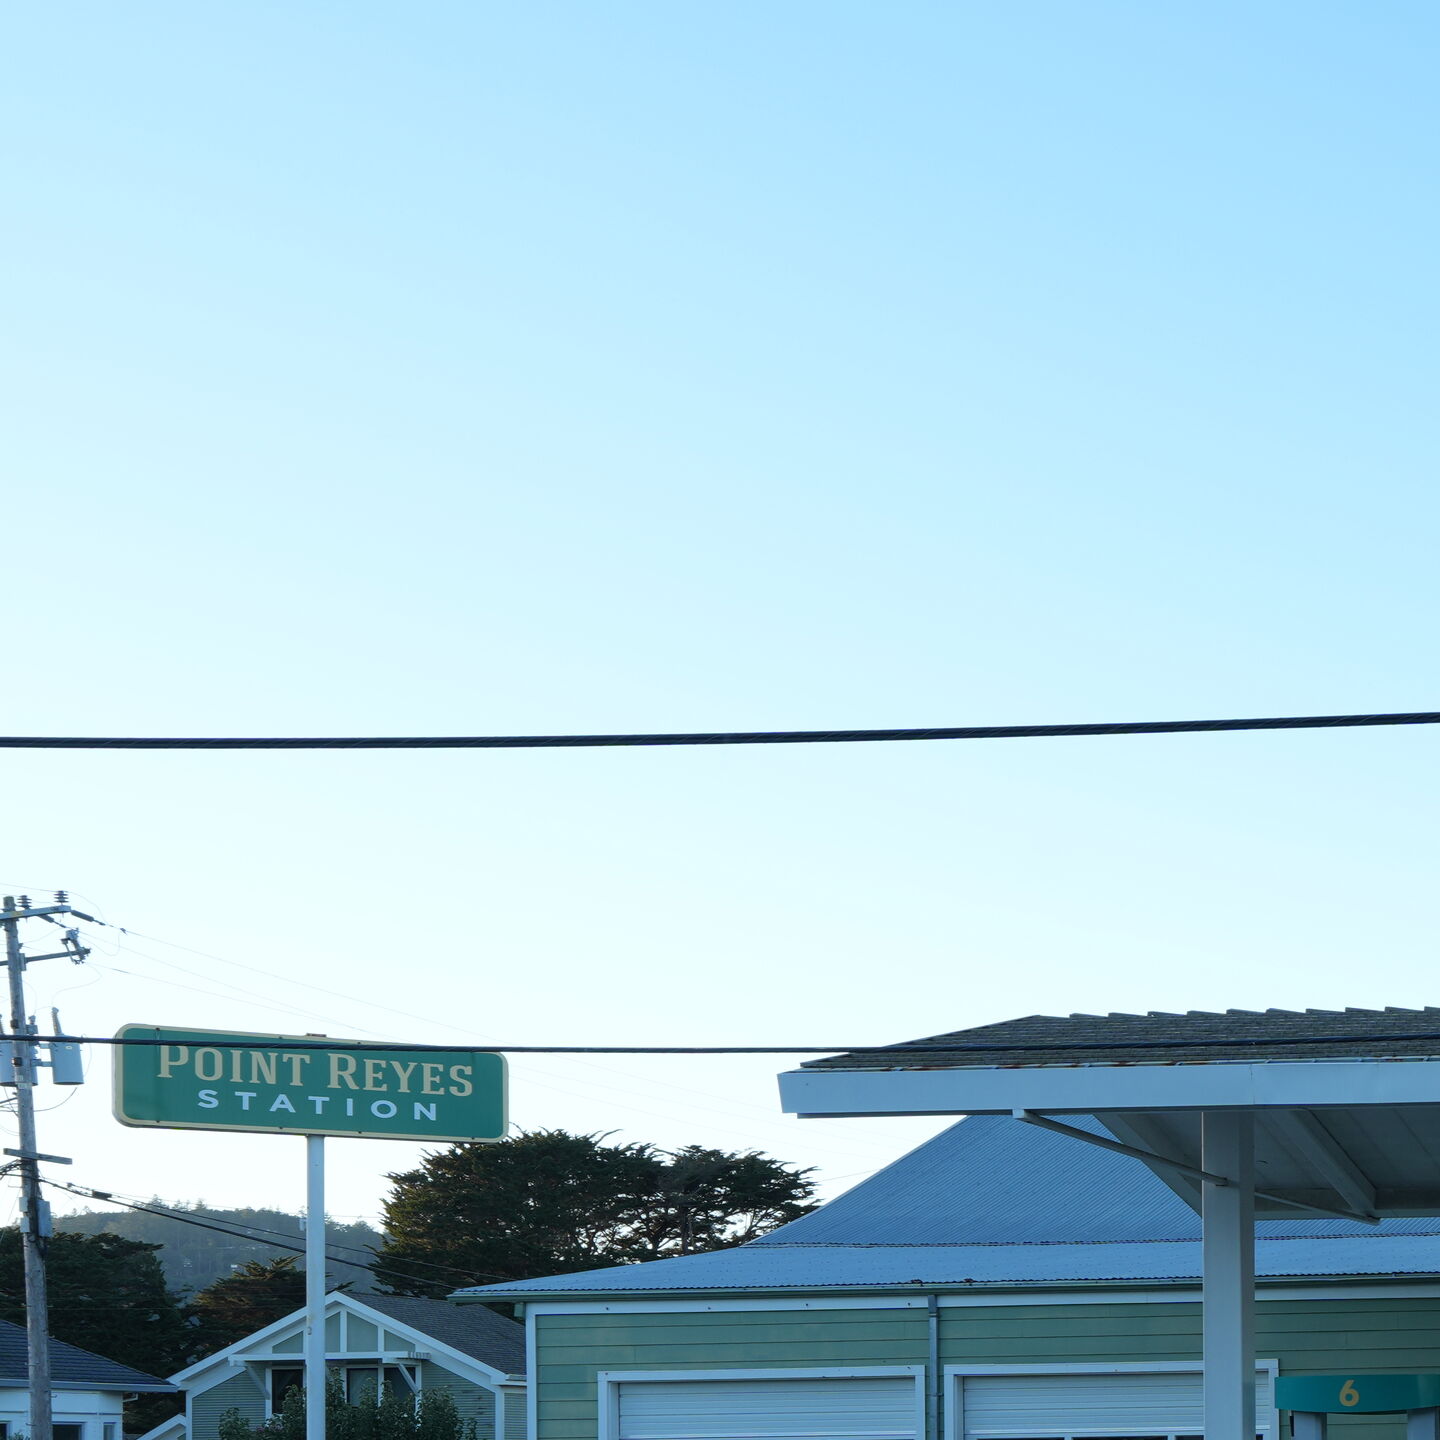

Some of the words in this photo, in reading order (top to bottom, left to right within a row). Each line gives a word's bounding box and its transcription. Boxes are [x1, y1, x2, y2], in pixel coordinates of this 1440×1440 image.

[158, 1044, 310, 1087] POINT
[327, 1053, 474, 1097] REYES
[197, 1089, 438, 1122] STATION
[1339, 1379, 1360, 1407] 6
